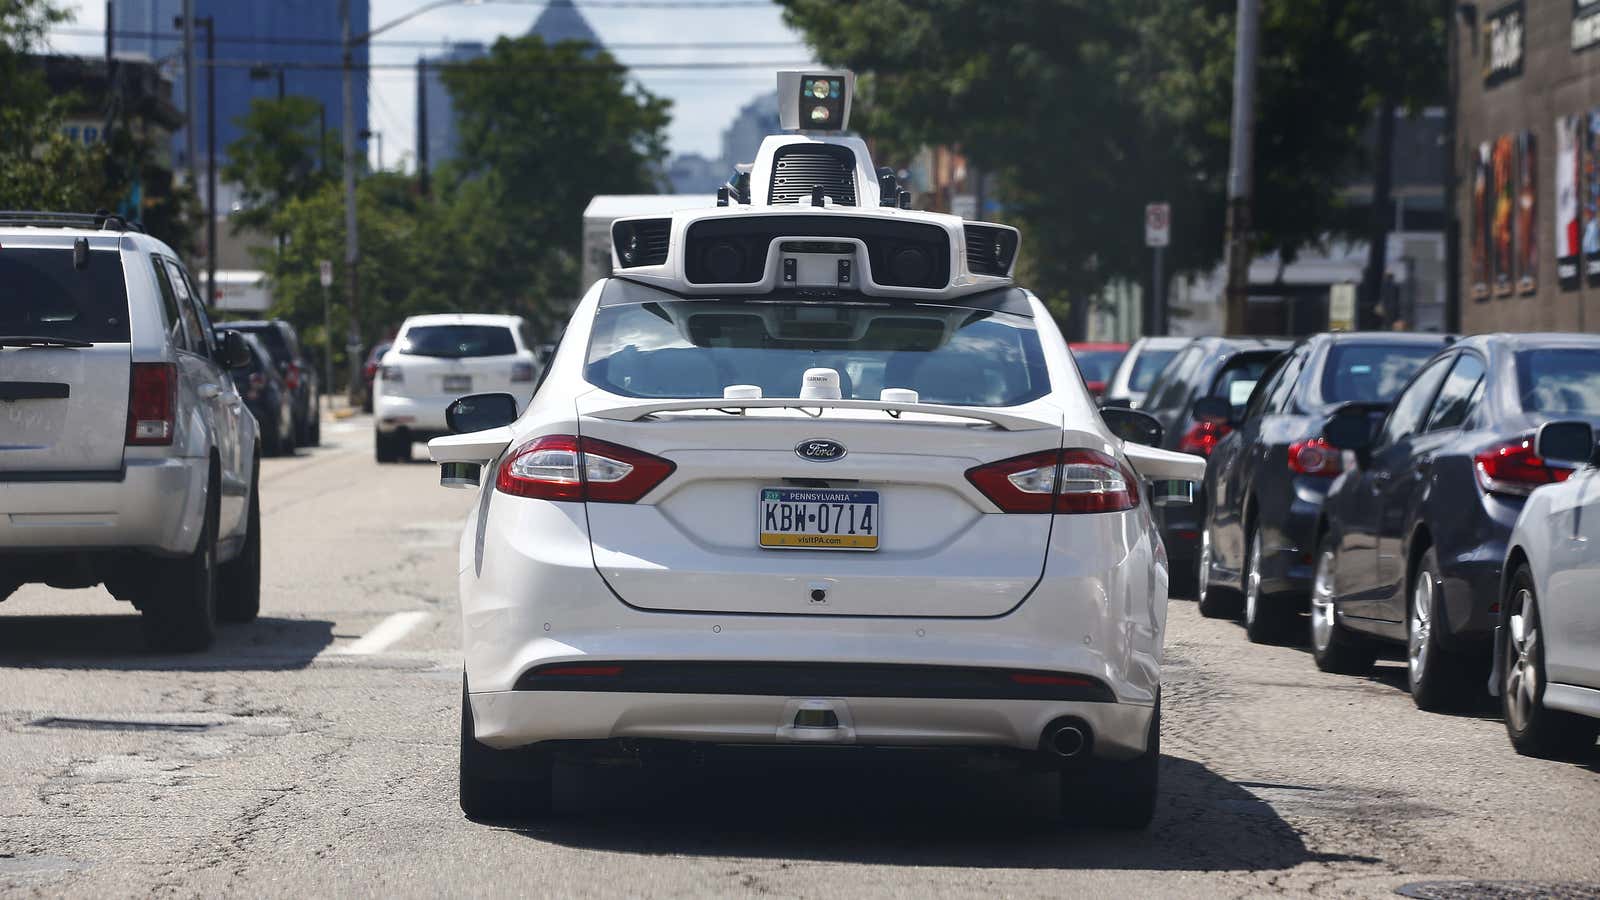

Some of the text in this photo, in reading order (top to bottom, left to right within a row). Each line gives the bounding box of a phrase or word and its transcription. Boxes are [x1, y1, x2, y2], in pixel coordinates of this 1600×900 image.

[806, 443, 836, 456] Ford
[790, 493, 850, 501] PENNSYLVANIA
[798, 537, 841, 545] visitPA.com
